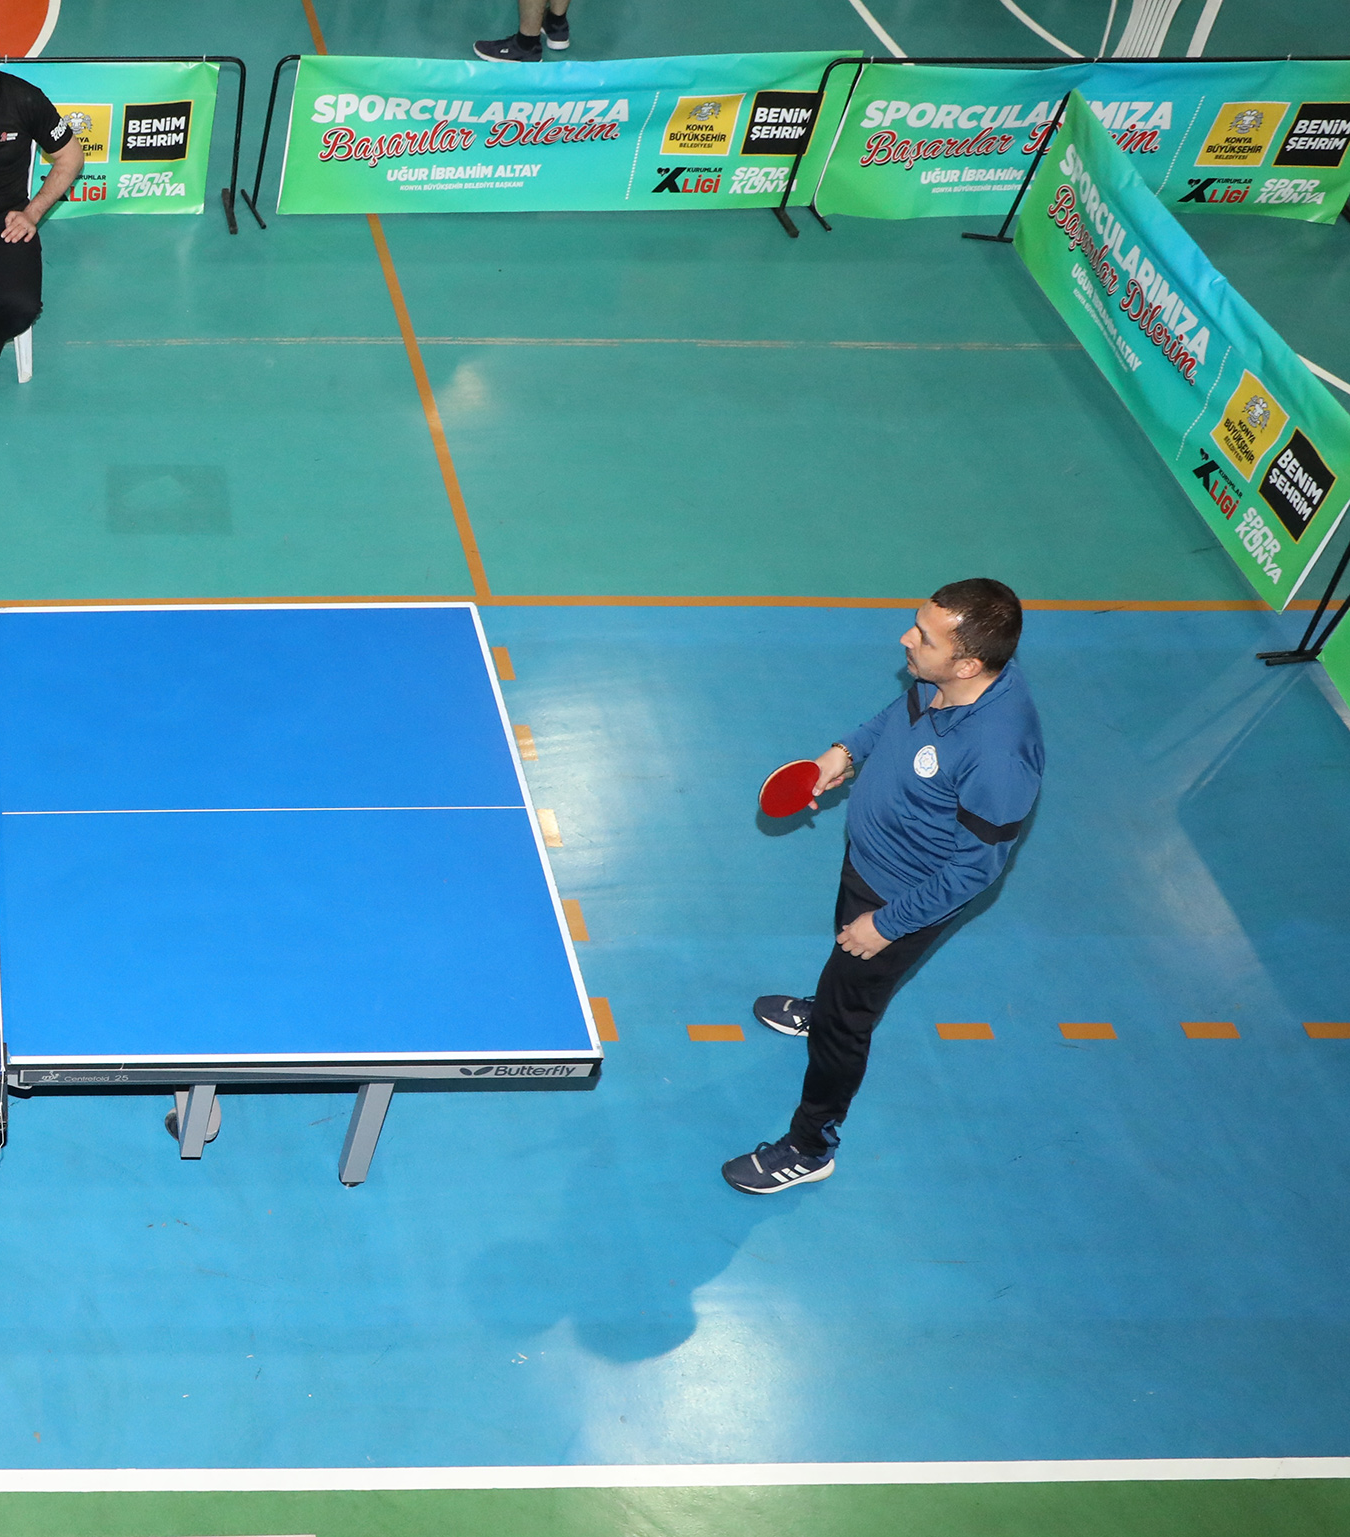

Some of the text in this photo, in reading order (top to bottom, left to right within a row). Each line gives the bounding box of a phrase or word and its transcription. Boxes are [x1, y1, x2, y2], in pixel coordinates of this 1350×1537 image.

[311, 93, 629, 124] SPORCULARIMIZA
[669, 131, 727, 143] BÜYÜKŞEHİR
[685, 124, 714, 132] KONYA
[318, 117, 620, 167] Başarılar Dilerim.
[859, 126, 1015, 169] Başarılar
[386, 163, 542, 182] UĞUR İBRAHİM ALTAY
[920, 167, 961, 185] UĞUR
[961, 166, 1025, 182] İBRAHİM
[1059, 144, 1210, 365] SPORCULARIMIZA
[1116, 335, 1142, 372] ALTAY
[1238, 420, 1256, 444] KONYA
[64, 1075, 109, 1083] Centrefold
[494, 1065, 576, 1077] Butterfly
